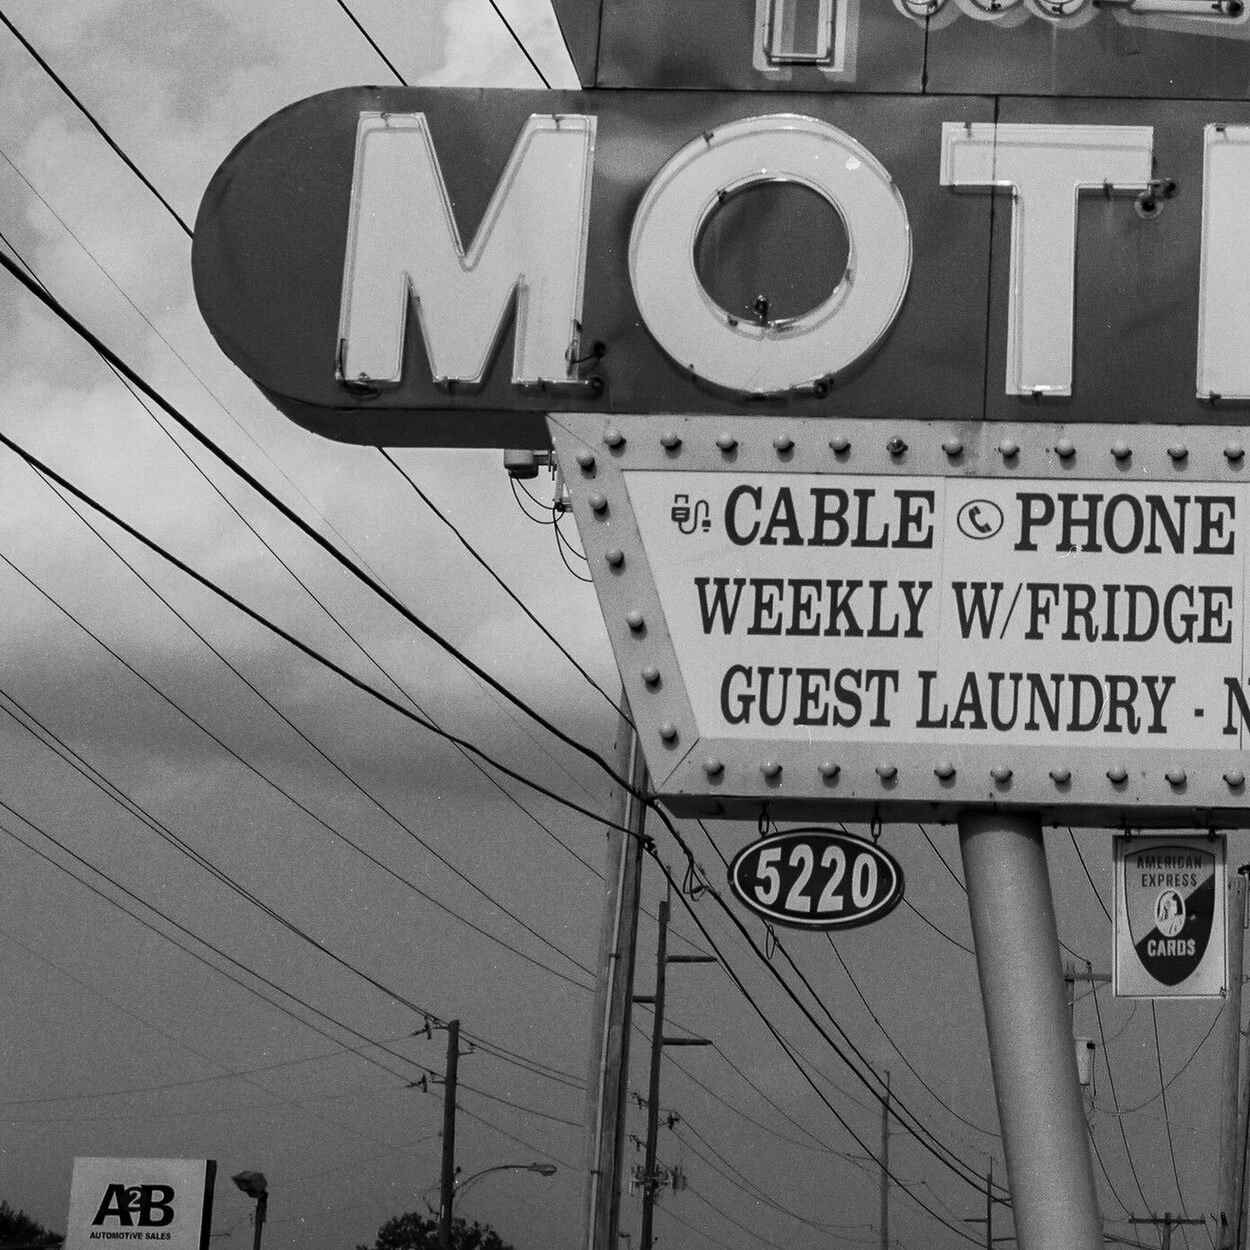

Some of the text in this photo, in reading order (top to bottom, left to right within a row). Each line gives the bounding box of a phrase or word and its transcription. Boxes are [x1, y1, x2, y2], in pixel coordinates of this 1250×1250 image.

[724, 484, 935, 549] CABLE
[1013, 492, 1236, 555] PHONE
[694, 577, 932, 638] WEEKLY
[952, 582, 1234, 644] W/FRIDGE
[720, 665, 899, 728] GUEST
[916, 670, 1176, 733] LAUNDRY
[754, 843, 878, 913] 5220
[1136, 855, 1202, 871] AMERICAN
[1141, 873, 1197, 888] EXPRESS
[1147, 938, 1196, 957] CARDS
[144, 1231, 171, 1240] SALES
